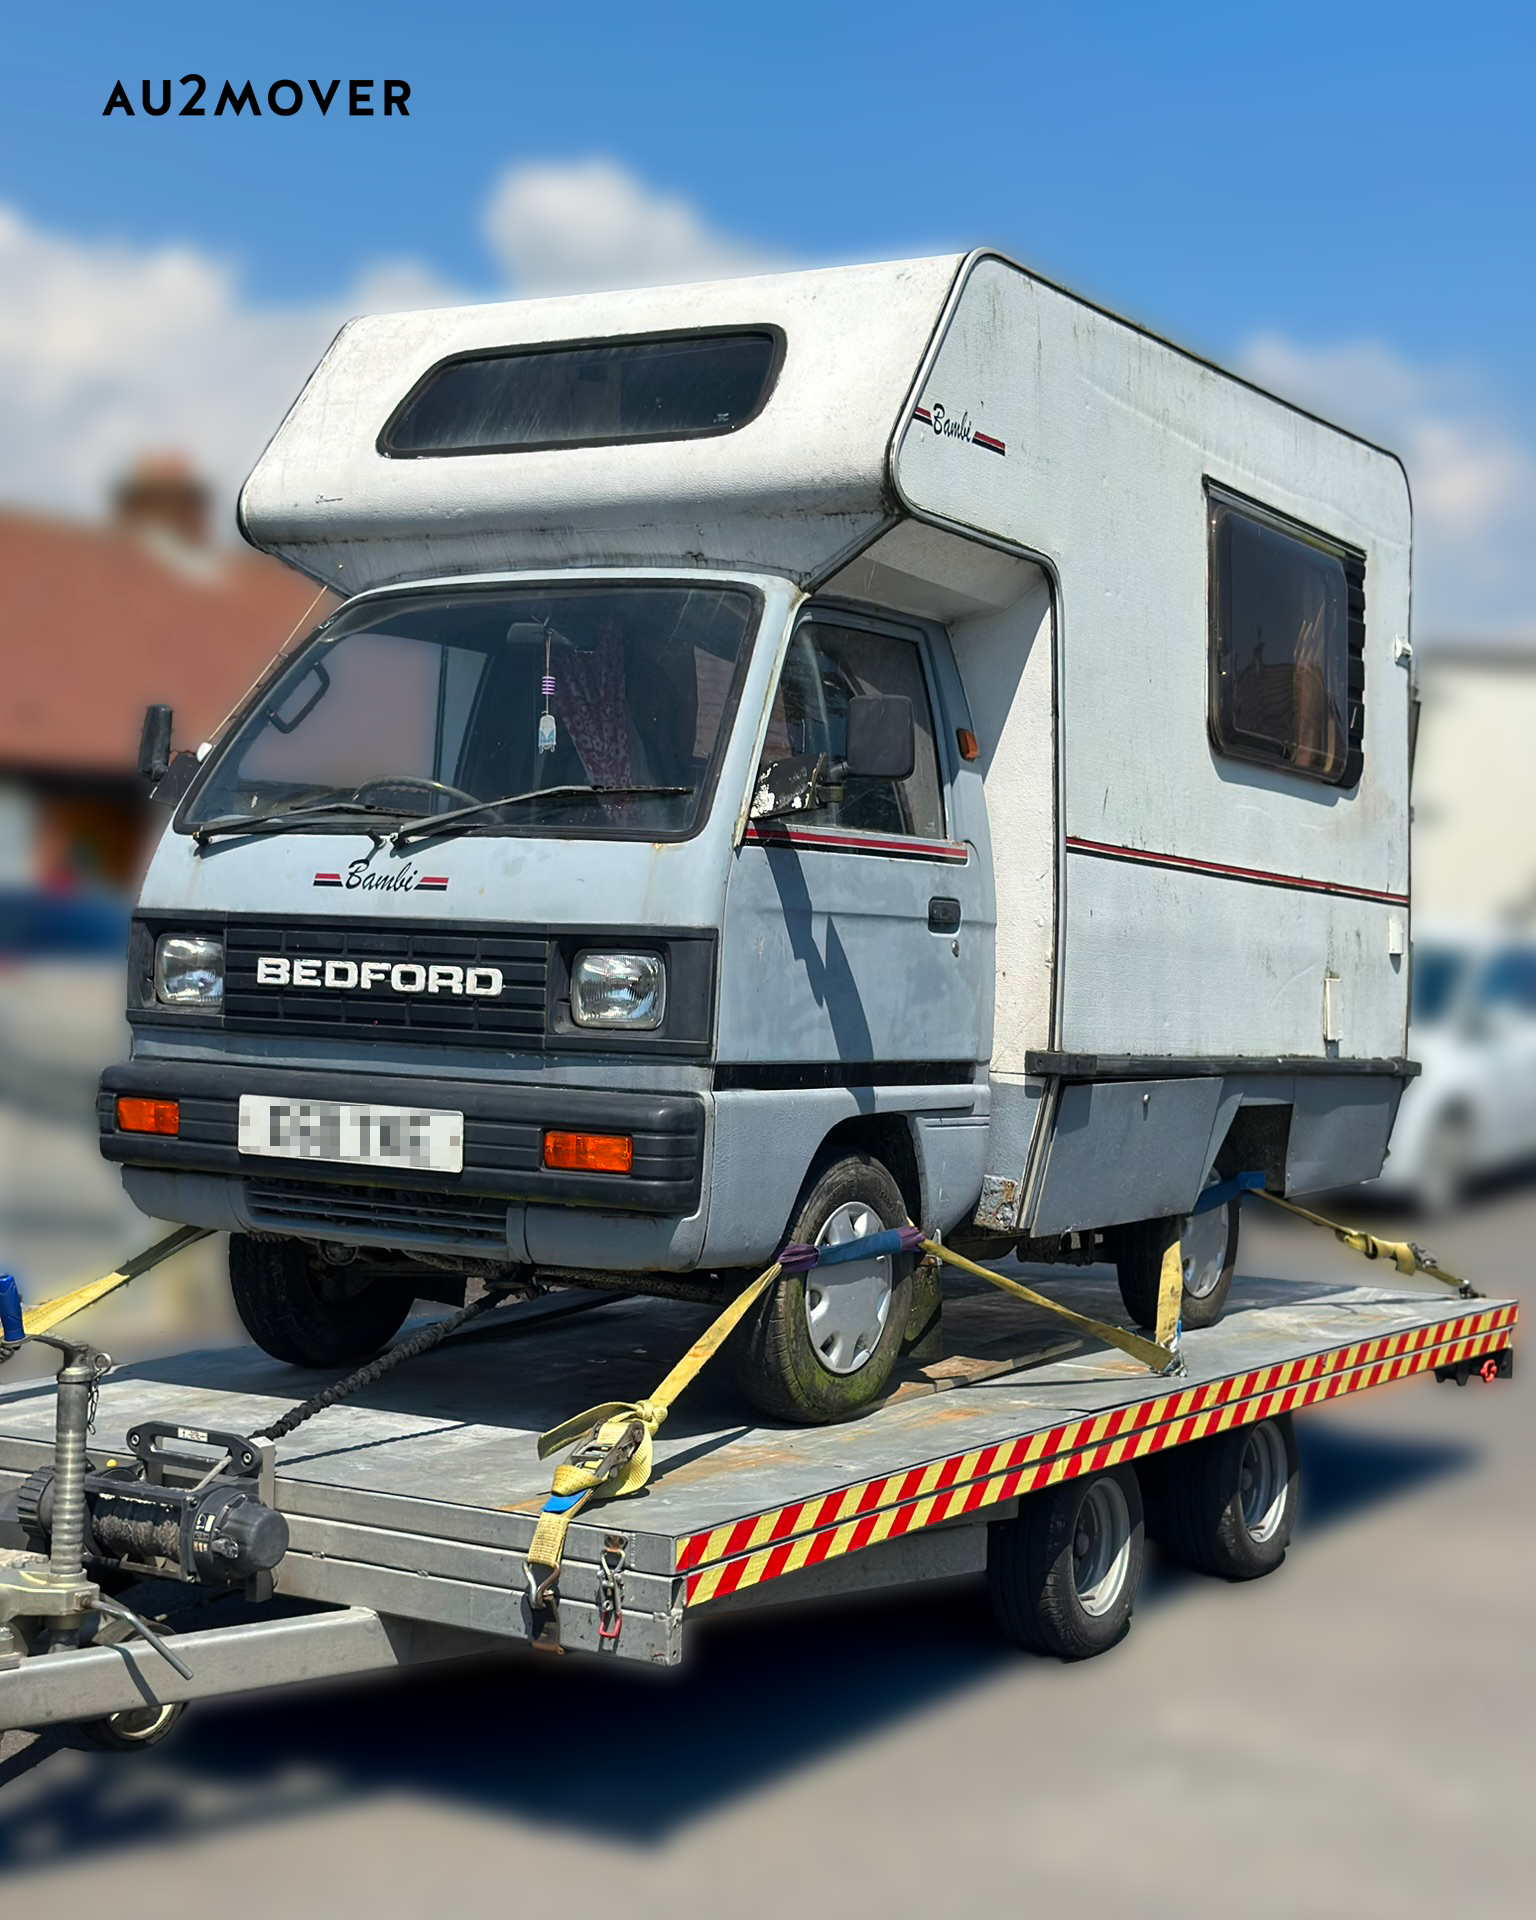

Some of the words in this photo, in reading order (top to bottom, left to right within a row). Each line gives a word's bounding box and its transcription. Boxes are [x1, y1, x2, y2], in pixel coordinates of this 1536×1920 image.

[933, 402, 972, 443] Bambi
[345, 858, 419, 892] Bambi
[257, 956, 504, 998] BEDFORD
